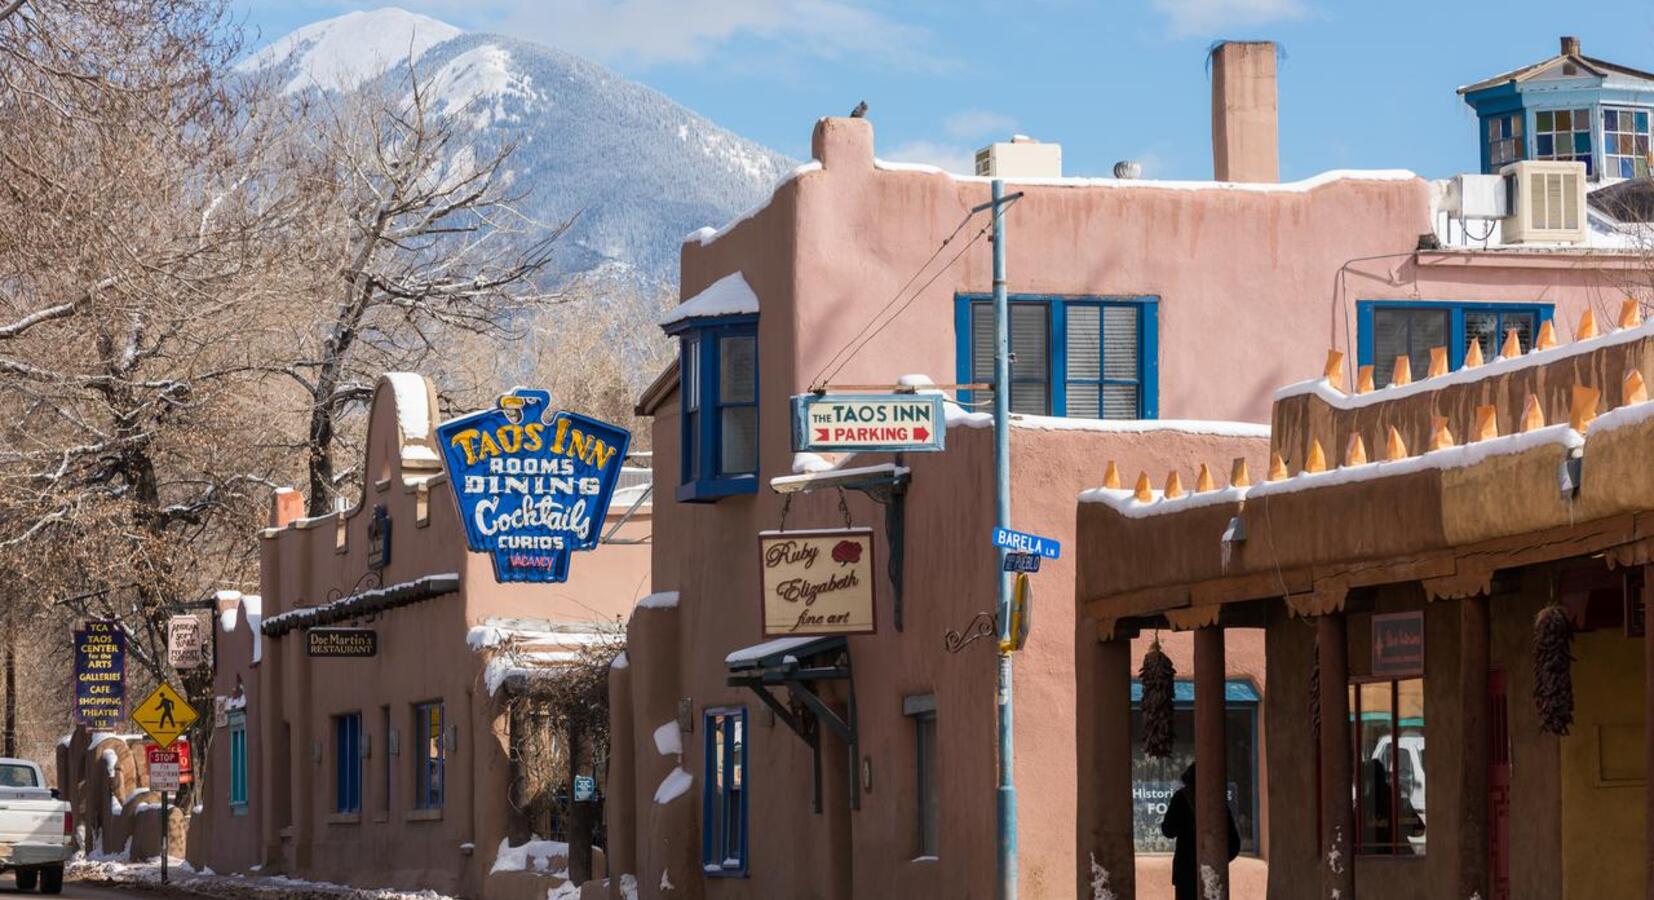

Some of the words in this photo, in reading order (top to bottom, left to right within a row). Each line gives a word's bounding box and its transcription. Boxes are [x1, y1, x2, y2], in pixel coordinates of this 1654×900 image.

[813, 414, 832, 423] THE
[833, 405, 887, 423] TAOS
[892, 405, 930, 422] INN
[834, 427, 908, 442] PARKING
[452, 423, 544, 466] TAOS
[549, 418, 616, 470] INN
[489, 457, 575, 475] ROOMS
[464, 475, 601, 495] DINING
[475, 495, 591, 540] Cocktails
[498, 535, 564, 550] CURIOS
[998, 530, 1042, 553] BARELA
[1045, 548, 1056, 557] LN
[766, 541, 819, 568] Ruby
[510, 555, 555, 571] VACANCY
[776, 570, 859, 605] Elizabeth
[794, 609, 823, 632] fine
[826, 612, 850, 625] art
[90, 623, 109, 632] TCA
[87, 635, 112, 643] TAOS
[310, 633, 328, 645] Doc
[330, 633, 372, 646] Martin's
[80, 644, 119, 653] CENTER
[310, 645, 372, 654] RESTAURANT
[87, 660, 112, 669] ARTS
[79, 673, 121, 681] GALLERIES
[89, 685, 111, 694] CAFE
[79, 697, 122, 706] SHOPPING
[82, 709, 119, 717] THEATER
[154, 753, 176, 762] STOP
[1132, 788, 1174, 799] Histori
[1147, 803, 1168, 815] FO
